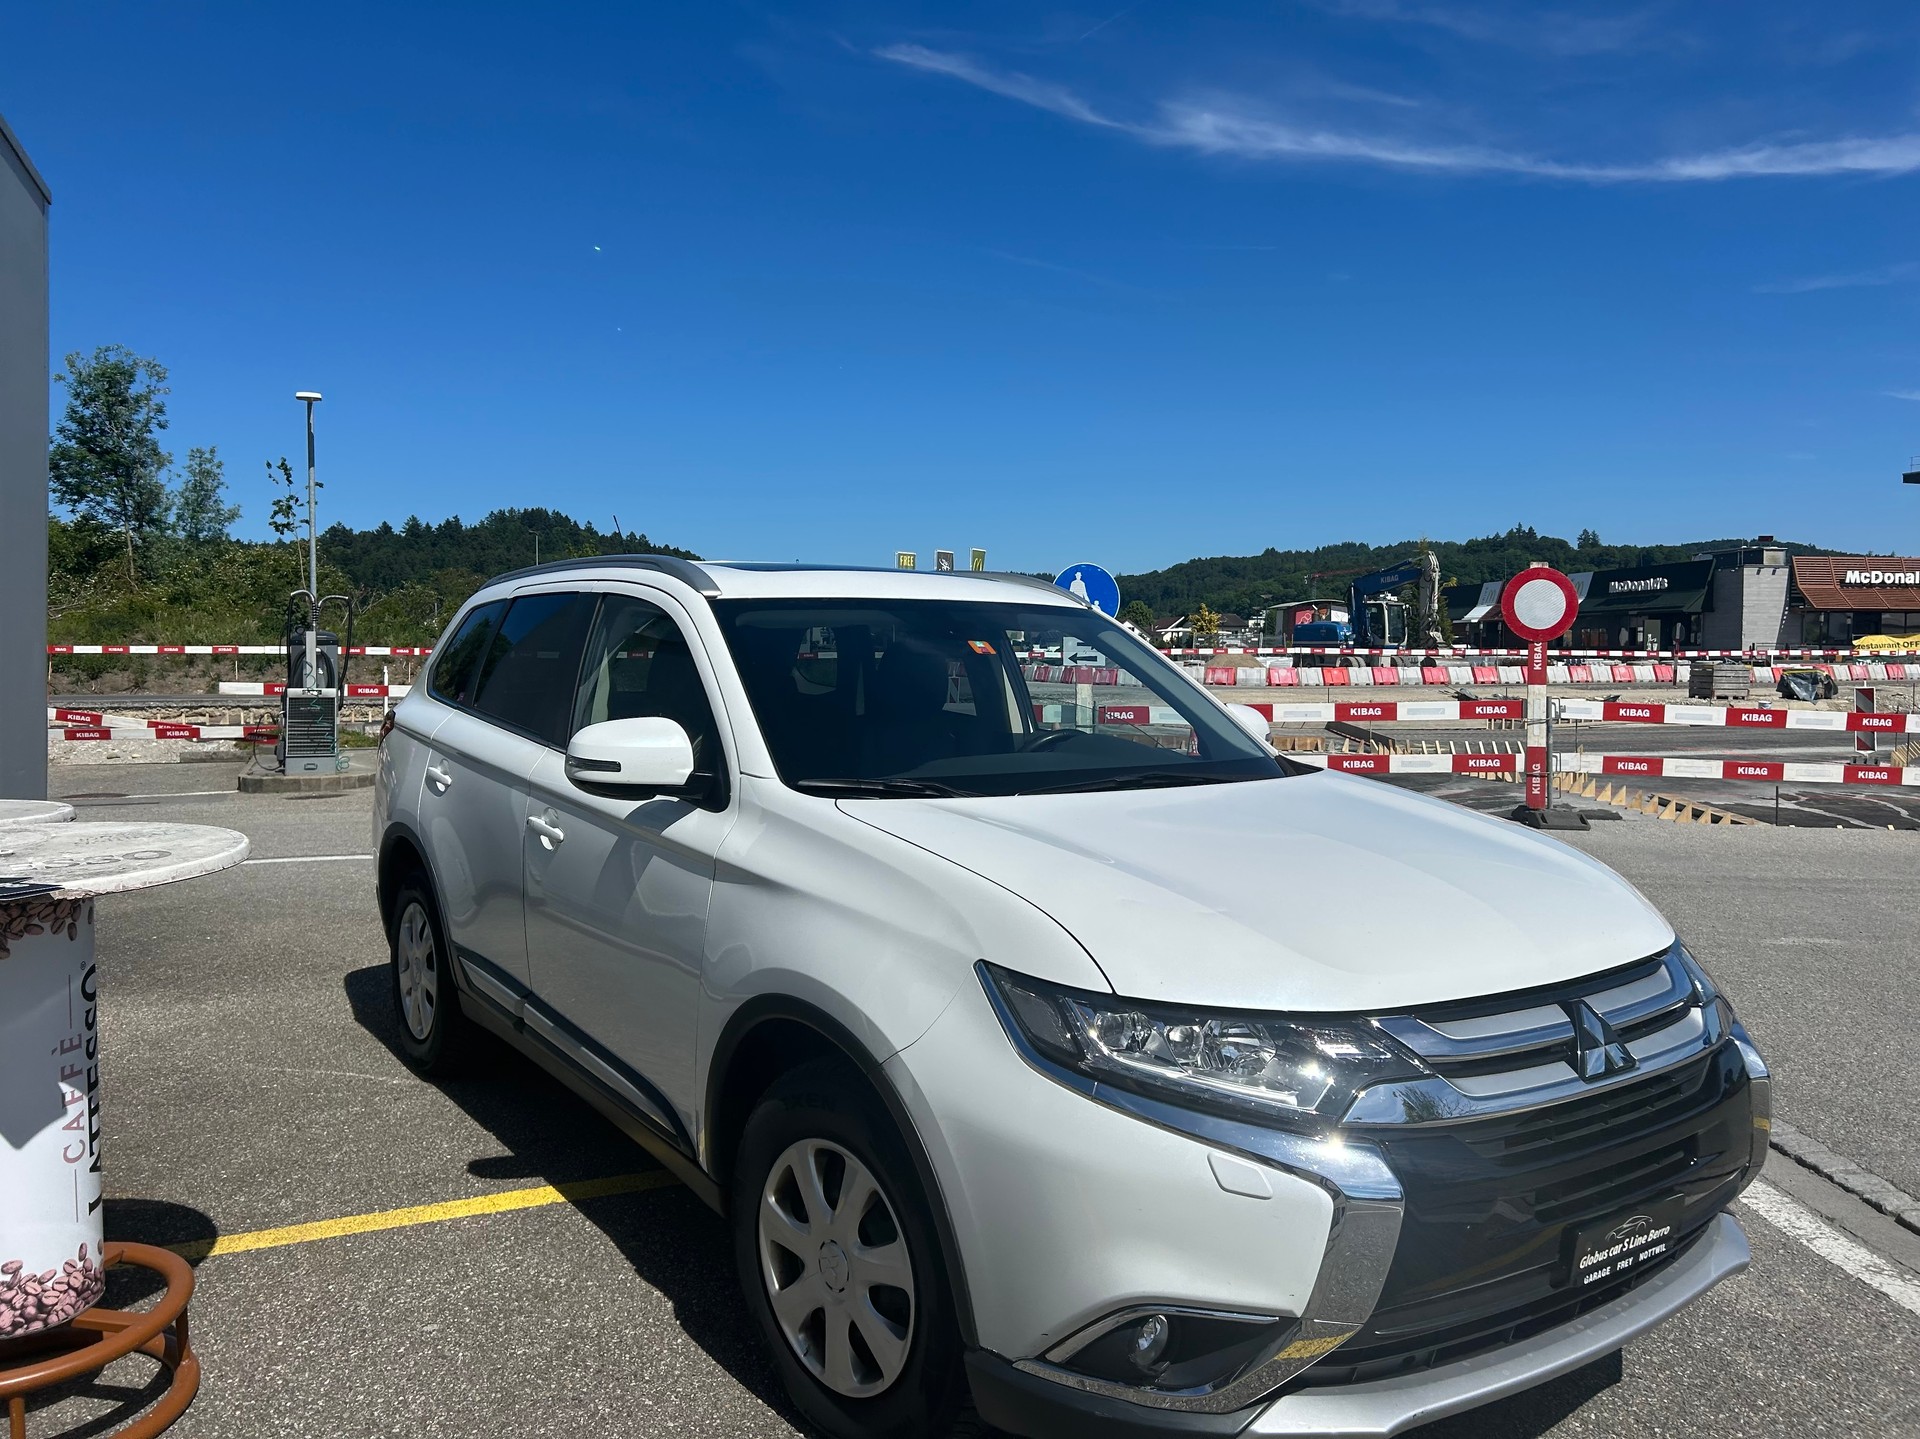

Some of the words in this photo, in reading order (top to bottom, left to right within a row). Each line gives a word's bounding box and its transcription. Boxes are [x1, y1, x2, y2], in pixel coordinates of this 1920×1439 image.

[900, 555, 914, 567] FREE
[1380, 574, 1399, 584] KIBAG
[1350, 707, 1382, 716] KIBAG
[1476, 706, 1507, 714] KIBAG
[1619, 708, 1650, 717] KIBAG
[67, 714, 91, 722] KIBAG
[1741, 713, 1773, 722] KIBAG
[1862, 718, 1892, 727] KIBAG
[1343, 760, 1375, 769] KIBAG
[1469, 759, 1501, 768] KIBAG
[1617, 762, 1648, 771] KIBAG
[1737, 766, 1768, 775] KIBAG
[1531, 763, 1541, 794] KIBAG
[1857, 771, 1888, 780] KIBAG
[51, 1033, 86, 1164] CAFFÈ
[1580, 1249, 1609, 1269] Globus
[1608, 1243, 1623, 1257] car
[1622, 1239, 1630, 1252] S
[1629, 1234, 1647, 1249] Line
[1647, 1226, 1670, 1242] Berro
[1584, 1267, 1611, 1284] GARAGE
[1616, 1257, 1634, 1271] FREY
[1639, 1244, 1666, 1261] NOTTWIL
